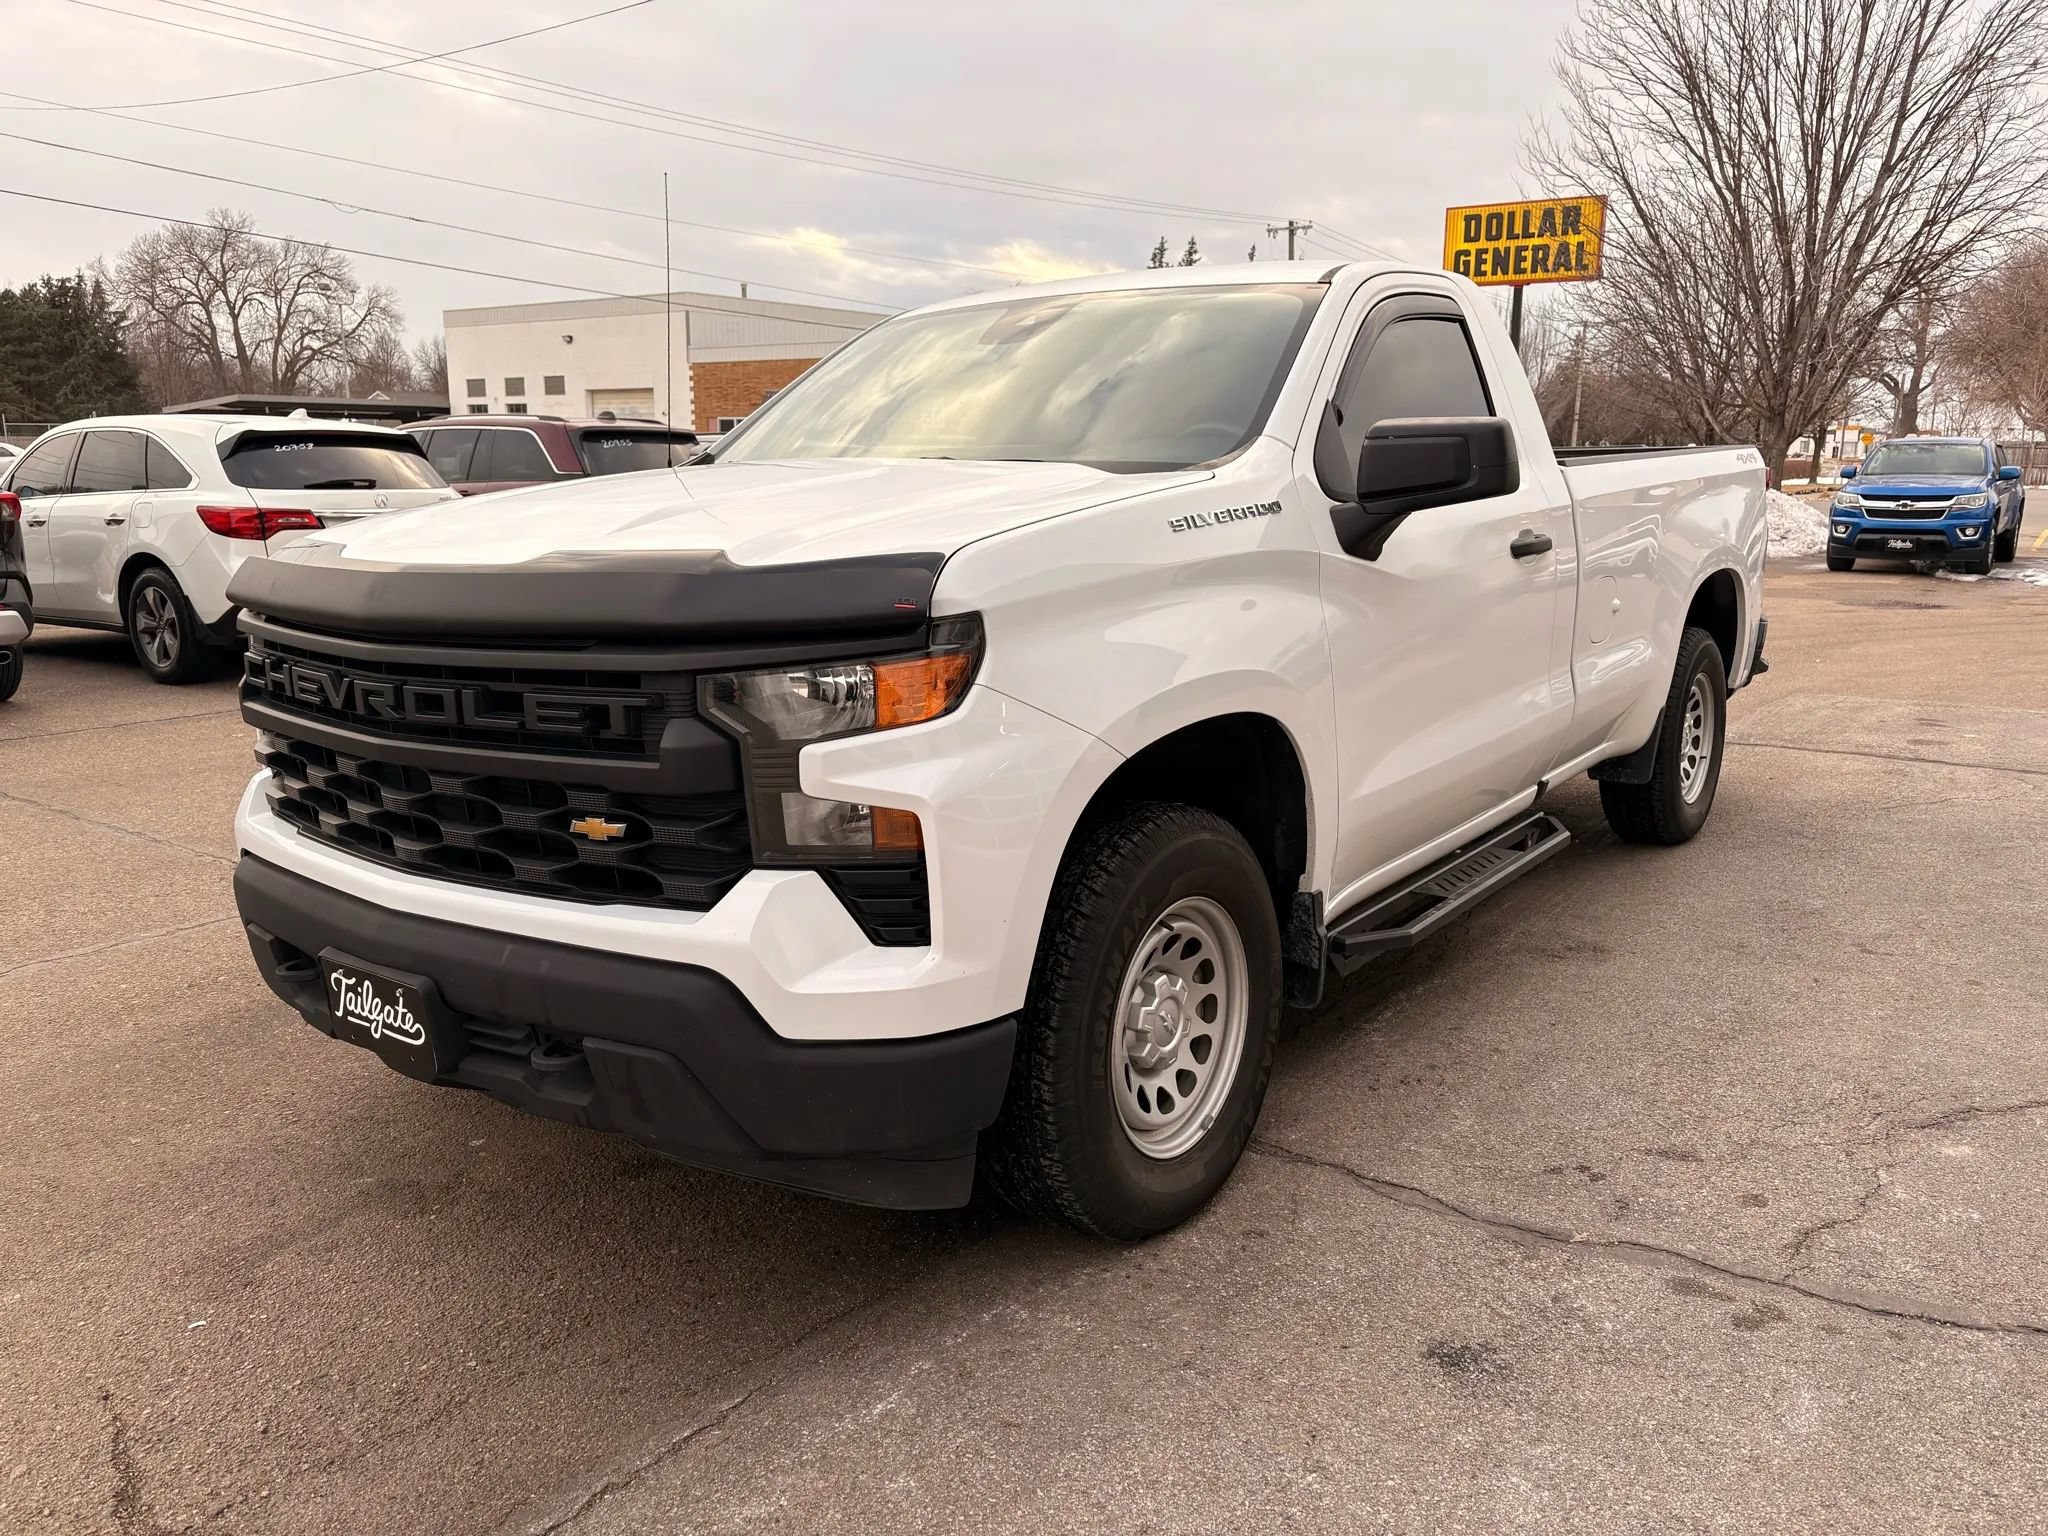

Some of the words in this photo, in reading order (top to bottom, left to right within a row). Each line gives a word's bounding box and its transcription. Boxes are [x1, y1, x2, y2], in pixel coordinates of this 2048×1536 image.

[1463, 205, 1582, 243] DOLLAR
[1453, 241, 1589, 277] GENERAL
[1168, 501, 1283, 533] SILVERADO
[243, 650, 662, 737] CHEVROLET
[331, 971, 426, 1046] Tailgate
